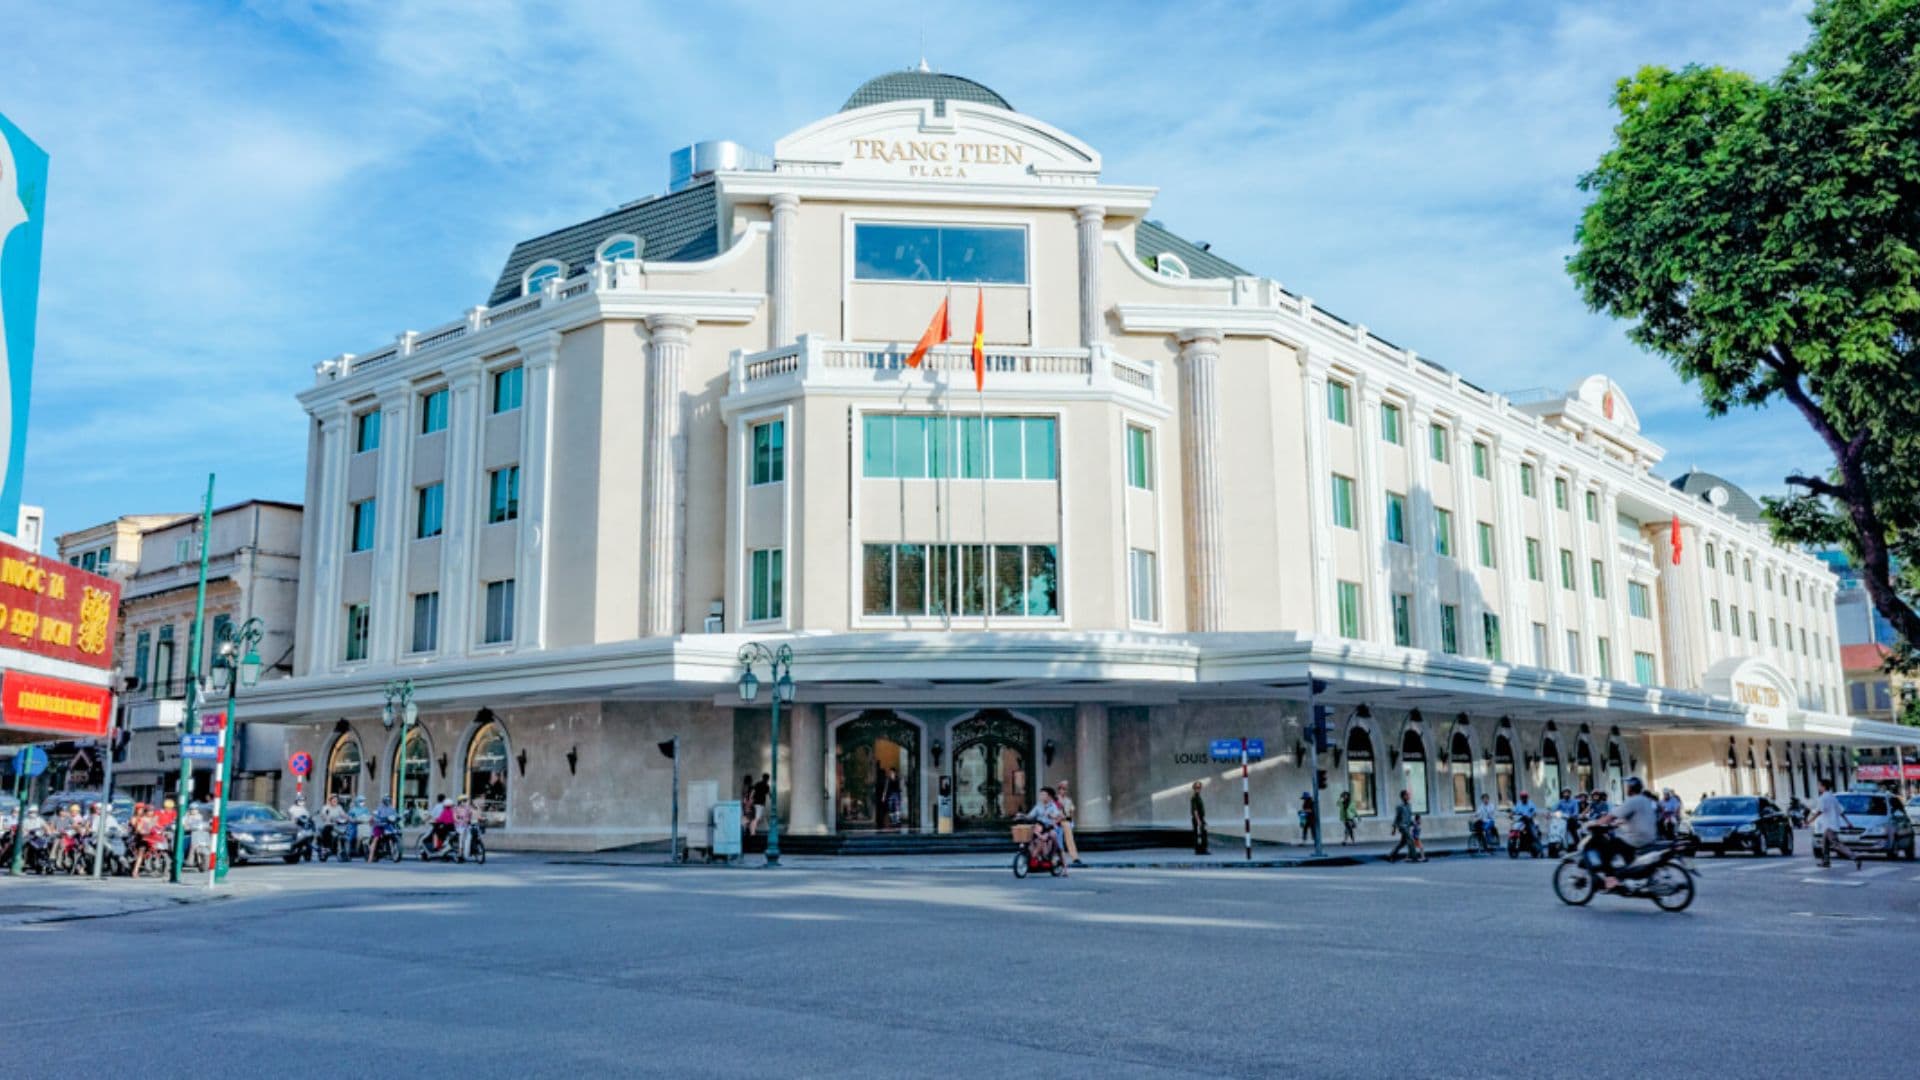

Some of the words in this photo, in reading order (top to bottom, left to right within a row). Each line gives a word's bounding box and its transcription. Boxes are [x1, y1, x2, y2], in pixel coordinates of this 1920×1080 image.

[850, 139, 950, 163] TRANG
[954, 143, 1025, 164] TIEN
[909, 165, 967, 178] PLAZA
[1174, 753, 1208, 764] LOUIS
